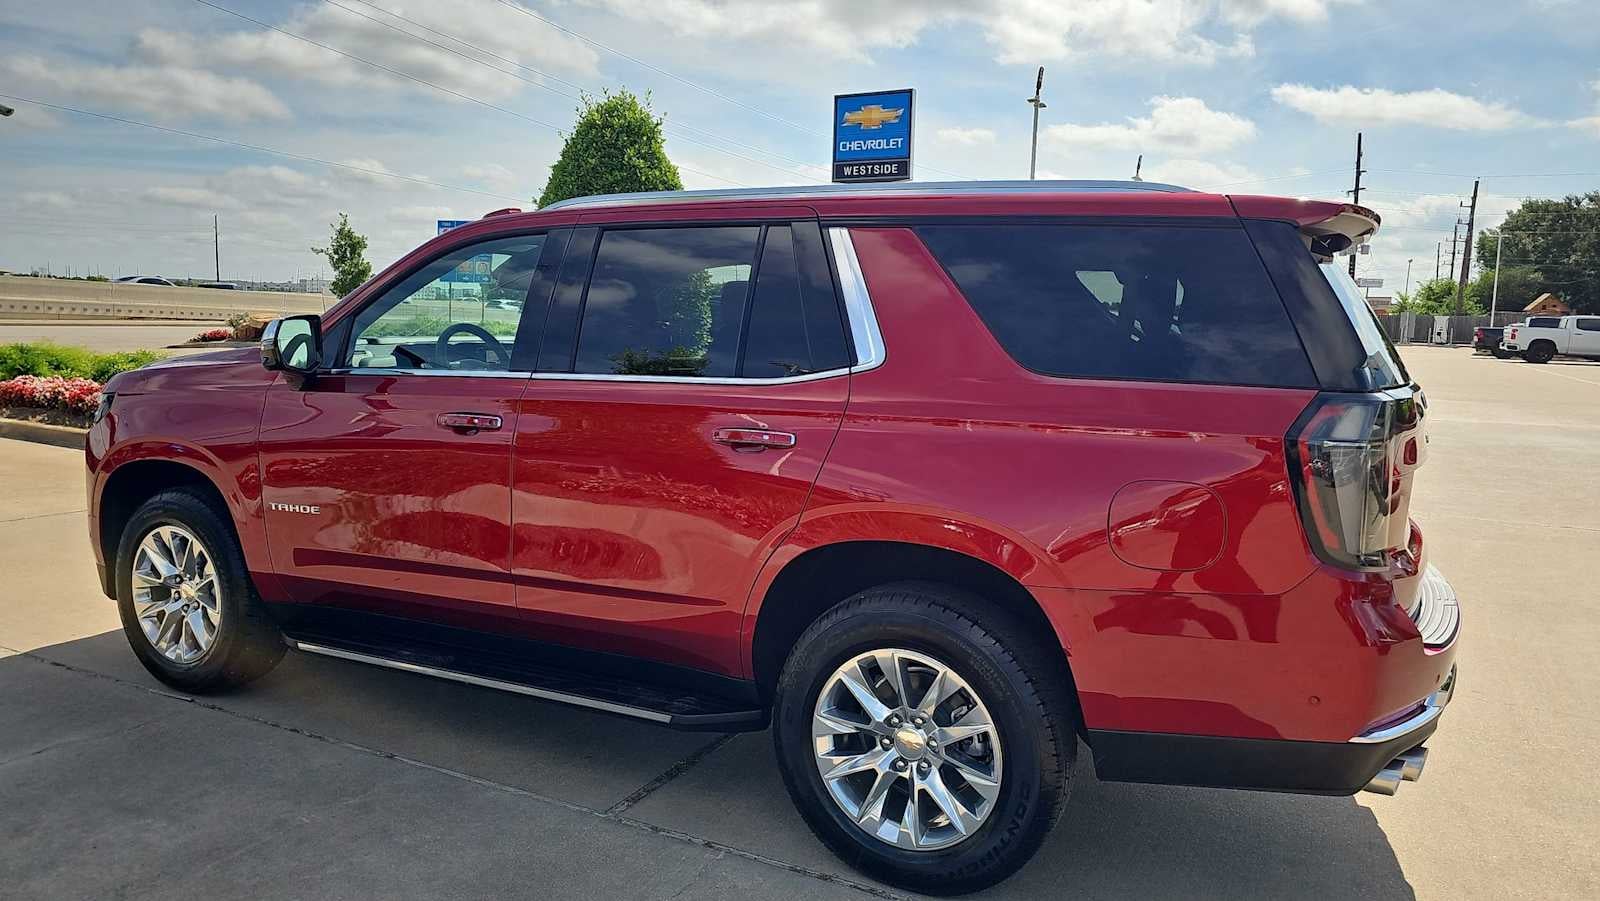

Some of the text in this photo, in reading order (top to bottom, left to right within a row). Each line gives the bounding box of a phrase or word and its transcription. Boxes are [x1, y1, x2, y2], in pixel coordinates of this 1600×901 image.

[840, 138, 904, 151] CHEVROLET
[843, 164, 899, 176] WESTSIDE
[269, 502, 321, 515] TAHOE
